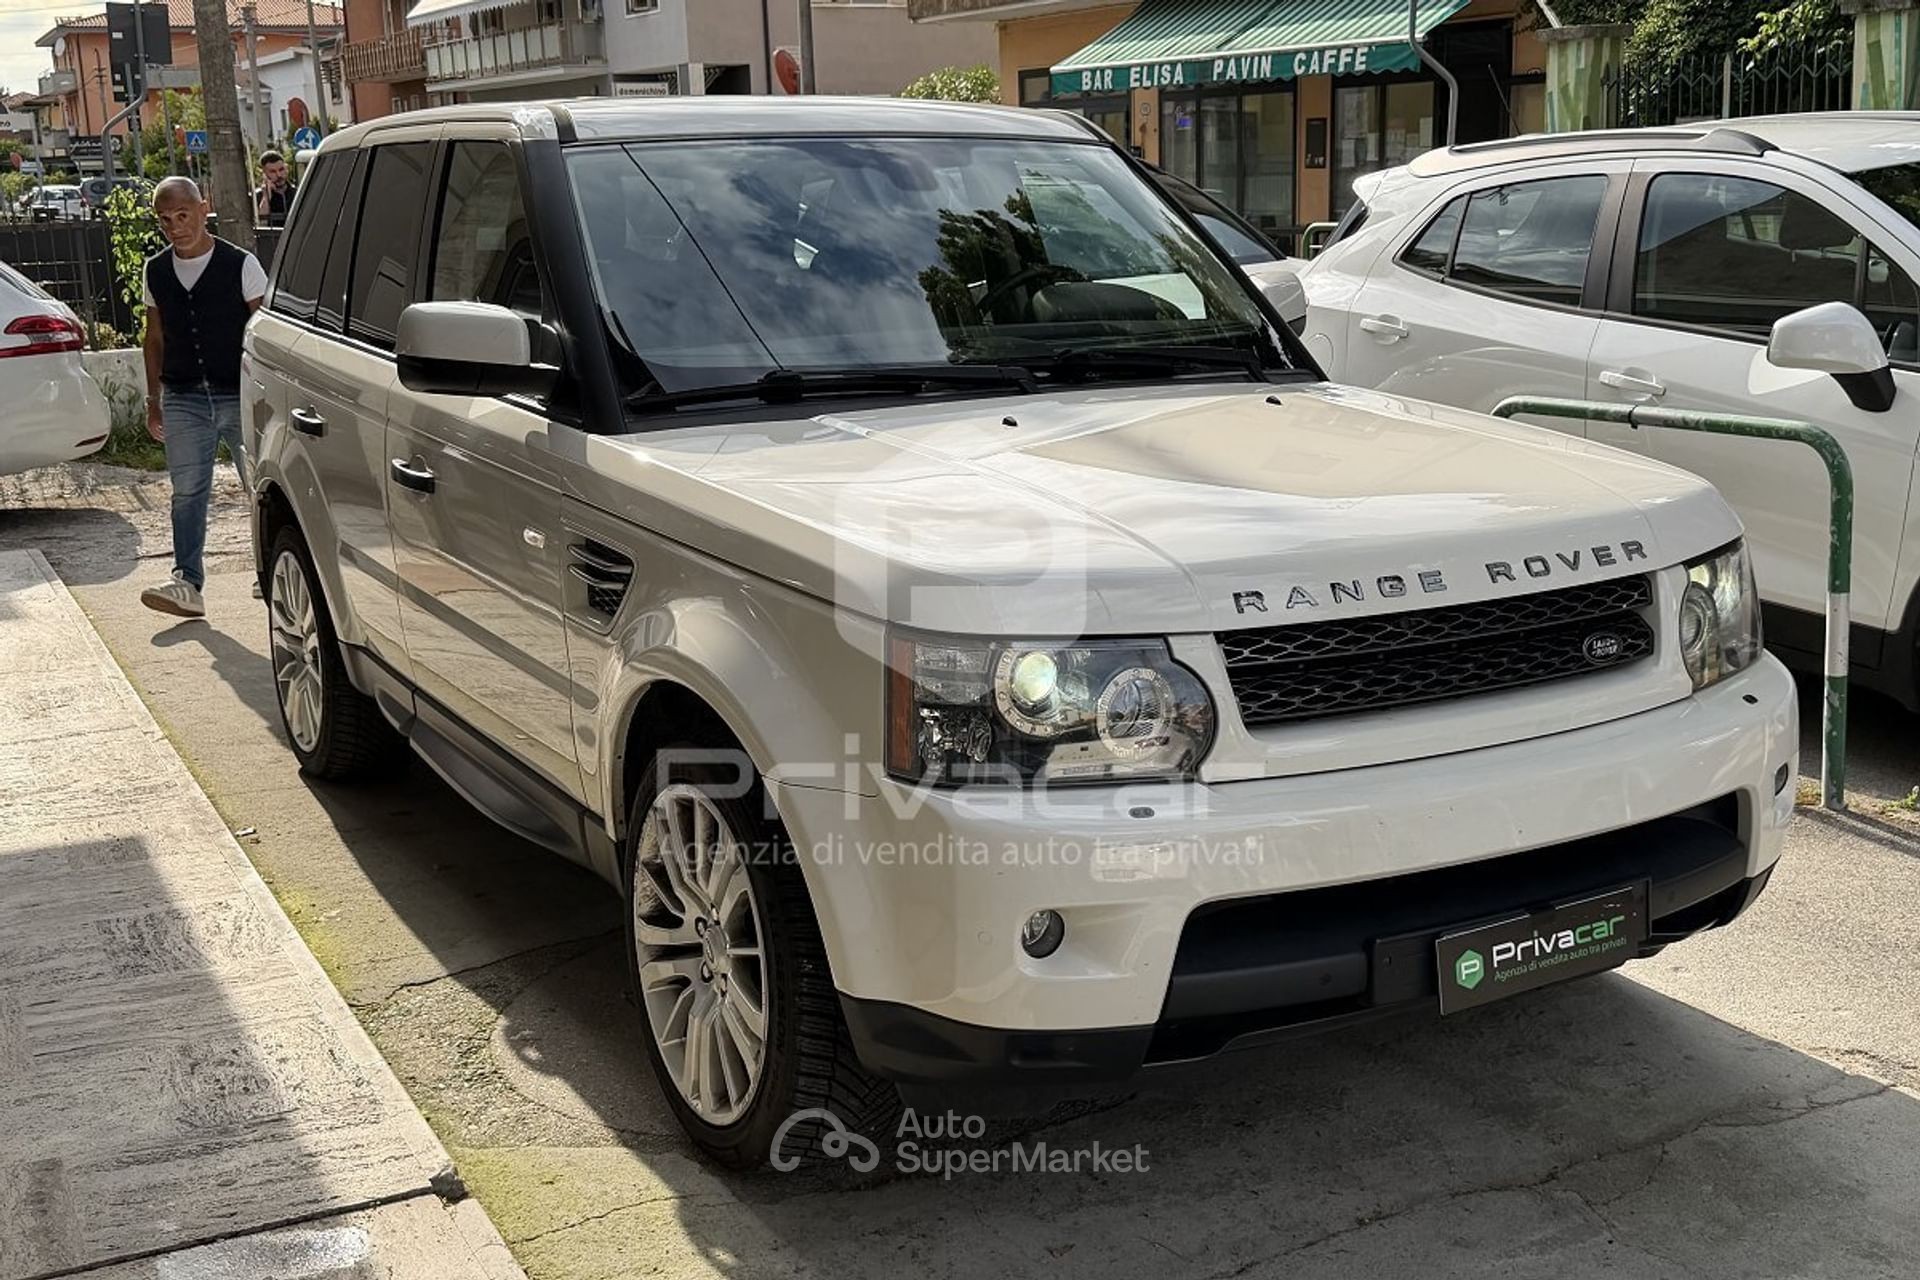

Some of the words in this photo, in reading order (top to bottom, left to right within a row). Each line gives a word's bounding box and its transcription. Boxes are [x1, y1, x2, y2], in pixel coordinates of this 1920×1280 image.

[1081, 68, 1113, 91] BAR
[1129, 62, 1184, 88] ELISA
[1212, 54, 1272, 81] PAVIN
[1232, 569, 1448, 614] RANGE
[1485, 540, 1648, 584] ROVER
[1494, 964, 1527, 983] Agenzia
[1538, 953, 1569, 969] vendita
[1570, 948, 1588, 960] auto
[1602, 936, 1628, 953] privati
